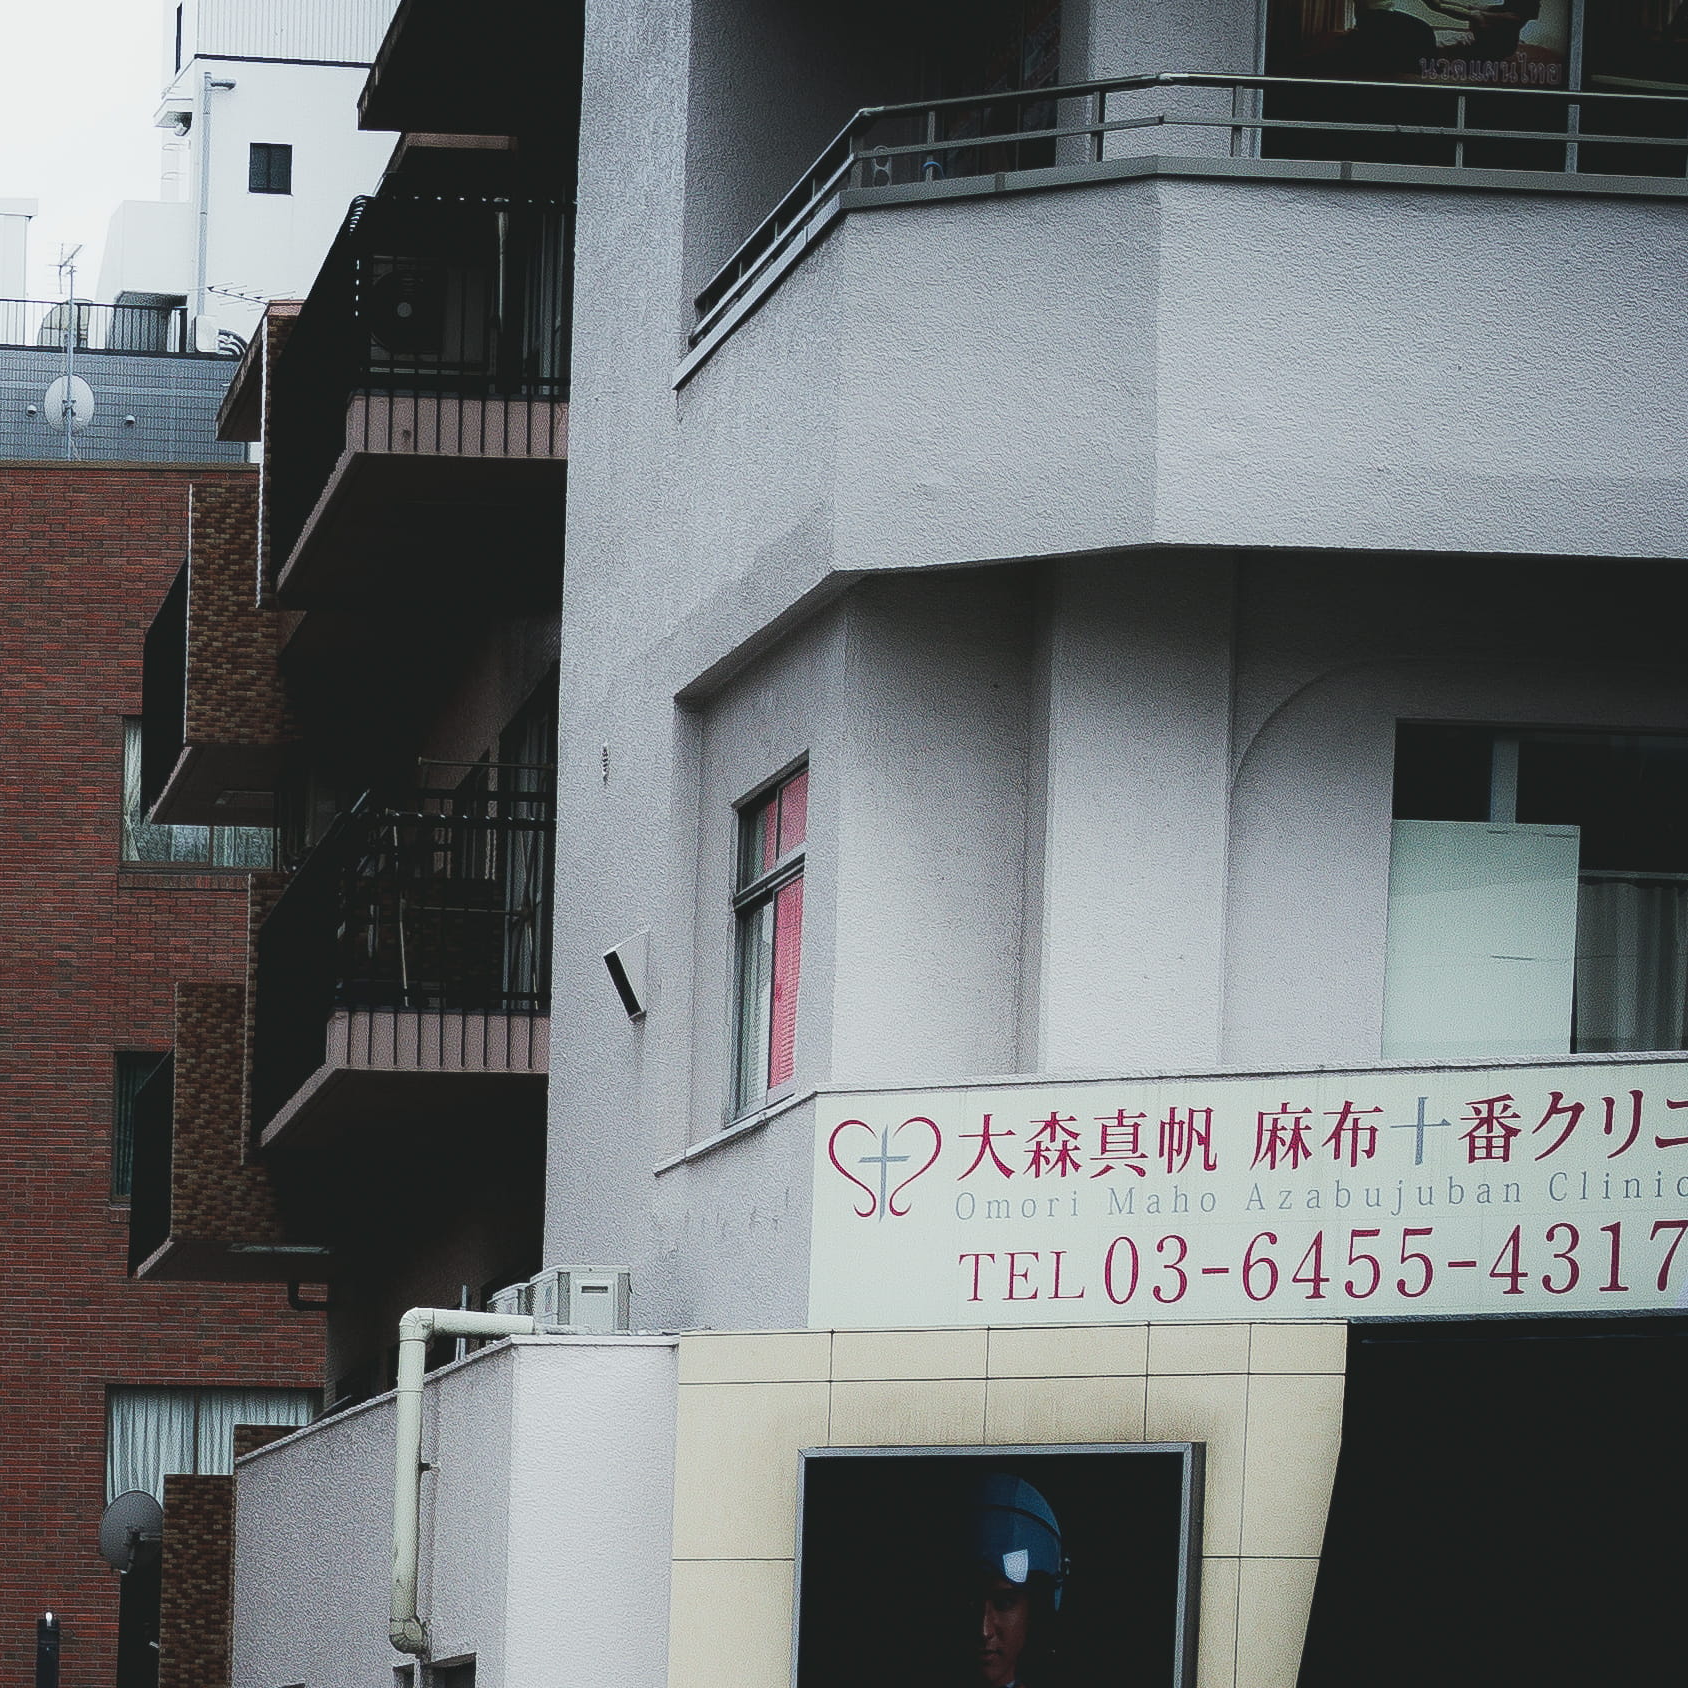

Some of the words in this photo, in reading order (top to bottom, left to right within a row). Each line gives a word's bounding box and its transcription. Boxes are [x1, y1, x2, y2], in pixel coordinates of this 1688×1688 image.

[956, 1105, 1218, 1183] 大森真帆
[955, 1189, 1081, 1221] Omori
[1107, 1184, 1218, 1216] Maho
[1245, 1170, 1522, 1217] Azabujuban
[958, 1250, 1086, 1303] TEL
[1103, 1219, 1688, 1305] 03-6455-4317
